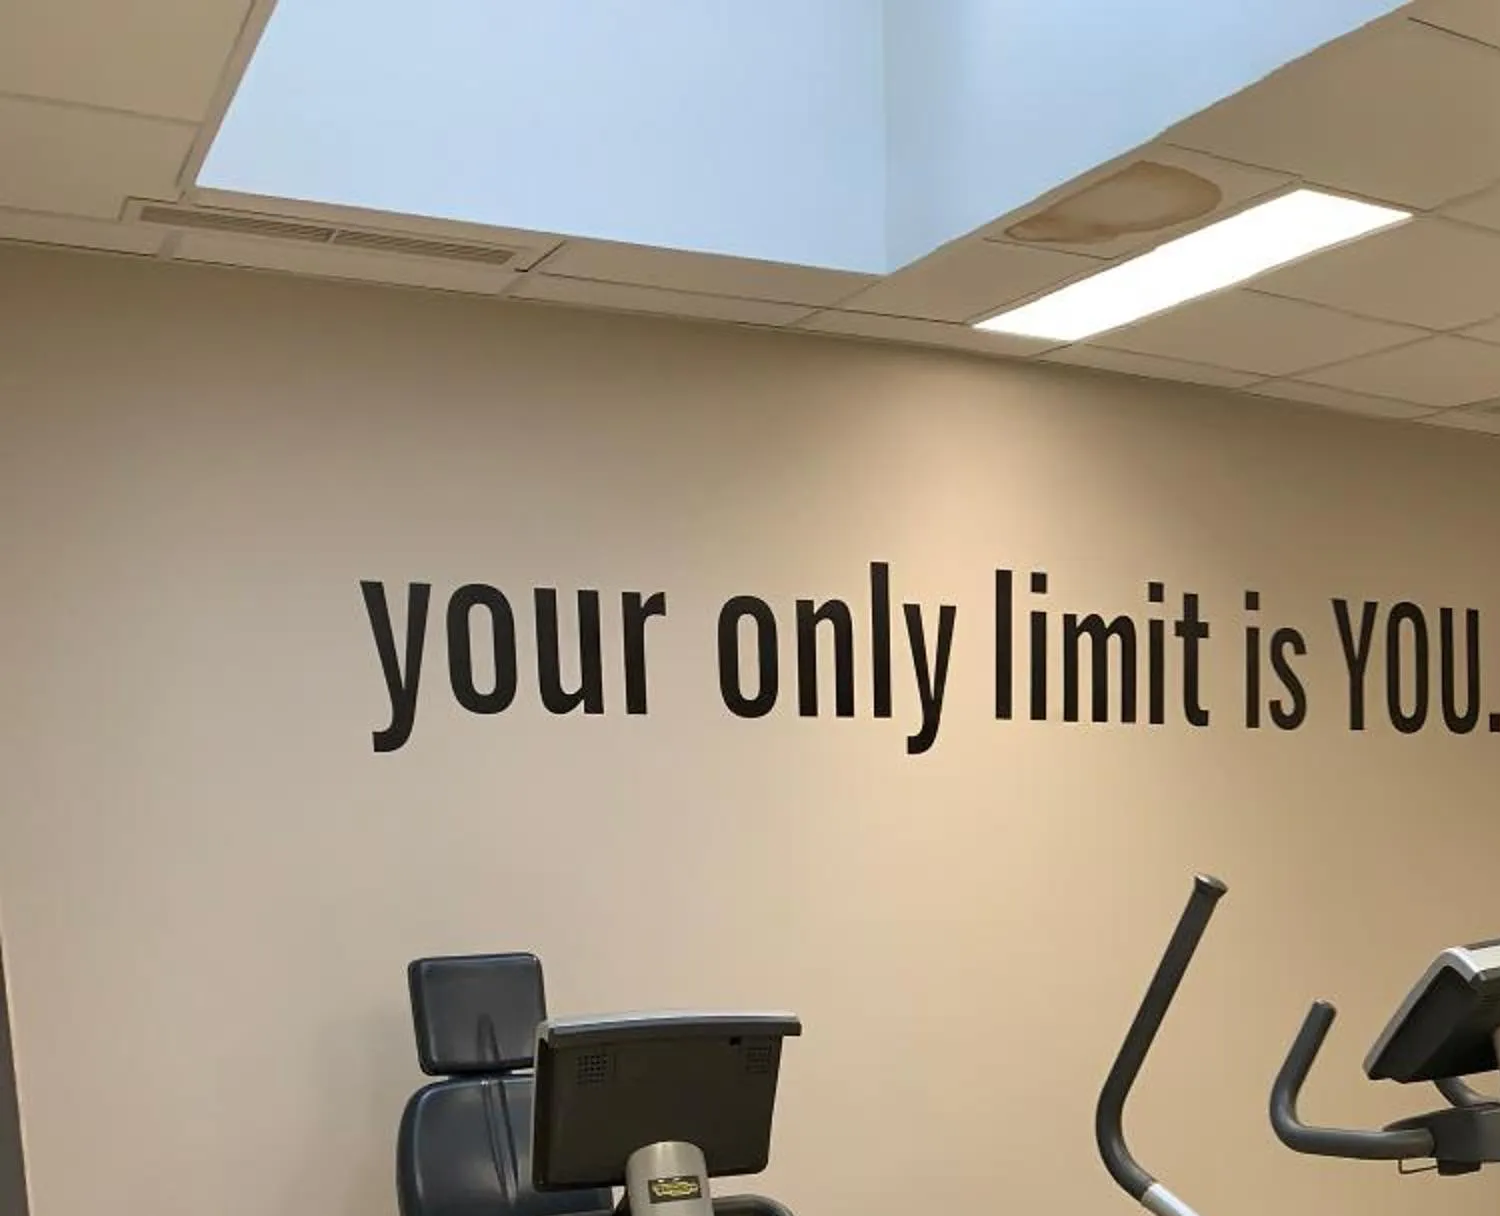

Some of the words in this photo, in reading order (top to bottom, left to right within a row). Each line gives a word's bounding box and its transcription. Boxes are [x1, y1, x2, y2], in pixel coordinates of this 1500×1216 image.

[360, 579, 667, 753] your
[718, 562, 957, 755] only
[996, 570, 1210, 727] limit
[1244, 590, 1307, 731] is
